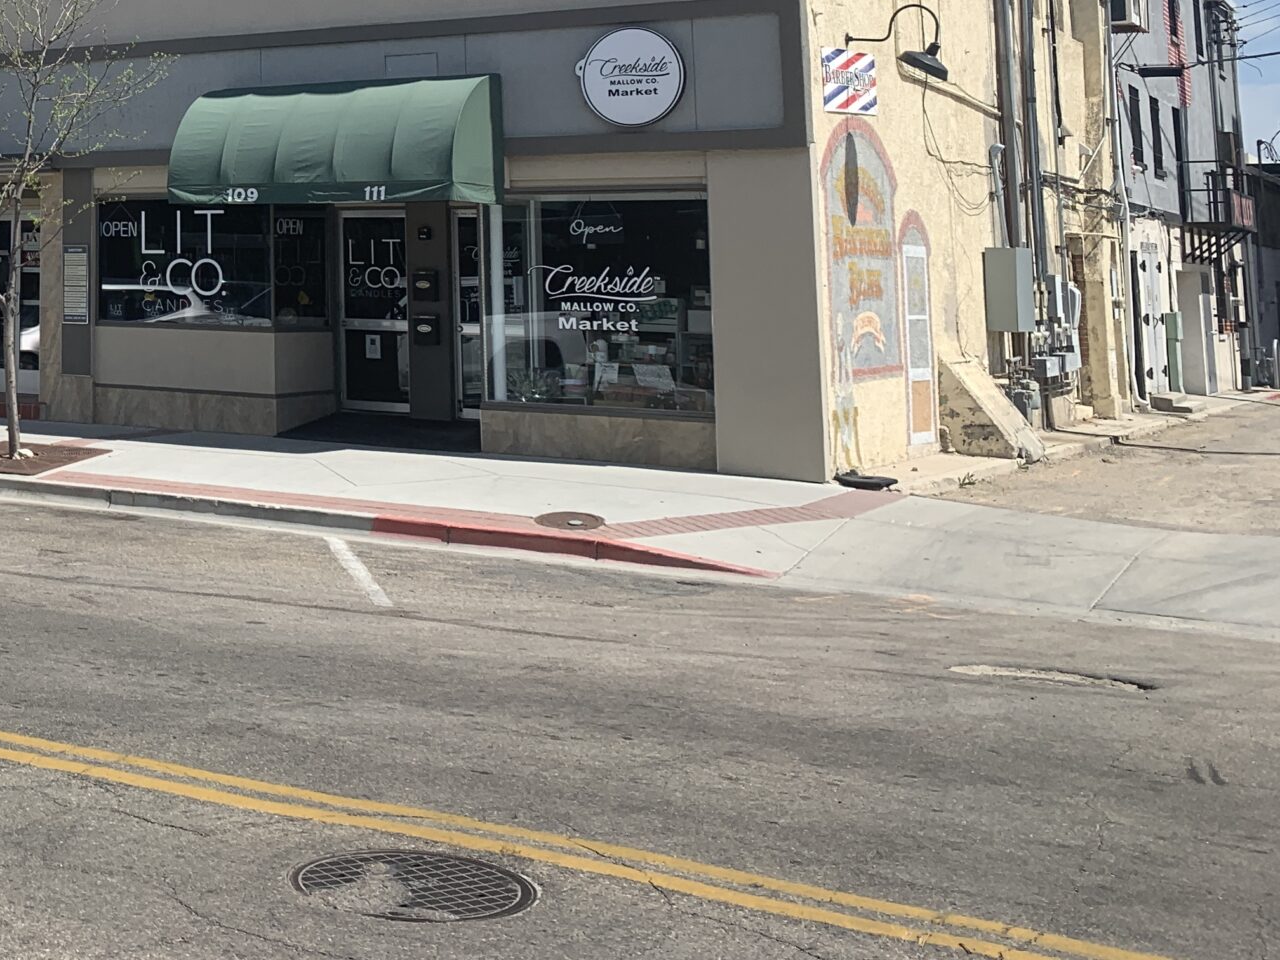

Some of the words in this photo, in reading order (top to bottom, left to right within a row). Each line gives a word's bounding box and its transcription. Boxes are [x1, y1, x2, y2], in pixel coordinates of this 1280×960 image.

[609, 78, 643, 86] MALLOW
[607, 87, 659, 97] Market
[226, 187, 260, 203] 109
[364, 185, 387, 201] 111
[101, 220, 138, 238] OPEN
[140, 209, 225, 255] LIT
[276, 218, 304, 235] OPEN
[570, 219, 624, 244] Open
[348, 239, 401, 265] LIT
[141, 298, 224, 313] CANDES
[560, 302, 615, 312] MALLOW
[617, 303, 640, 313] CO.
[557, 317, 639, 332] Market
